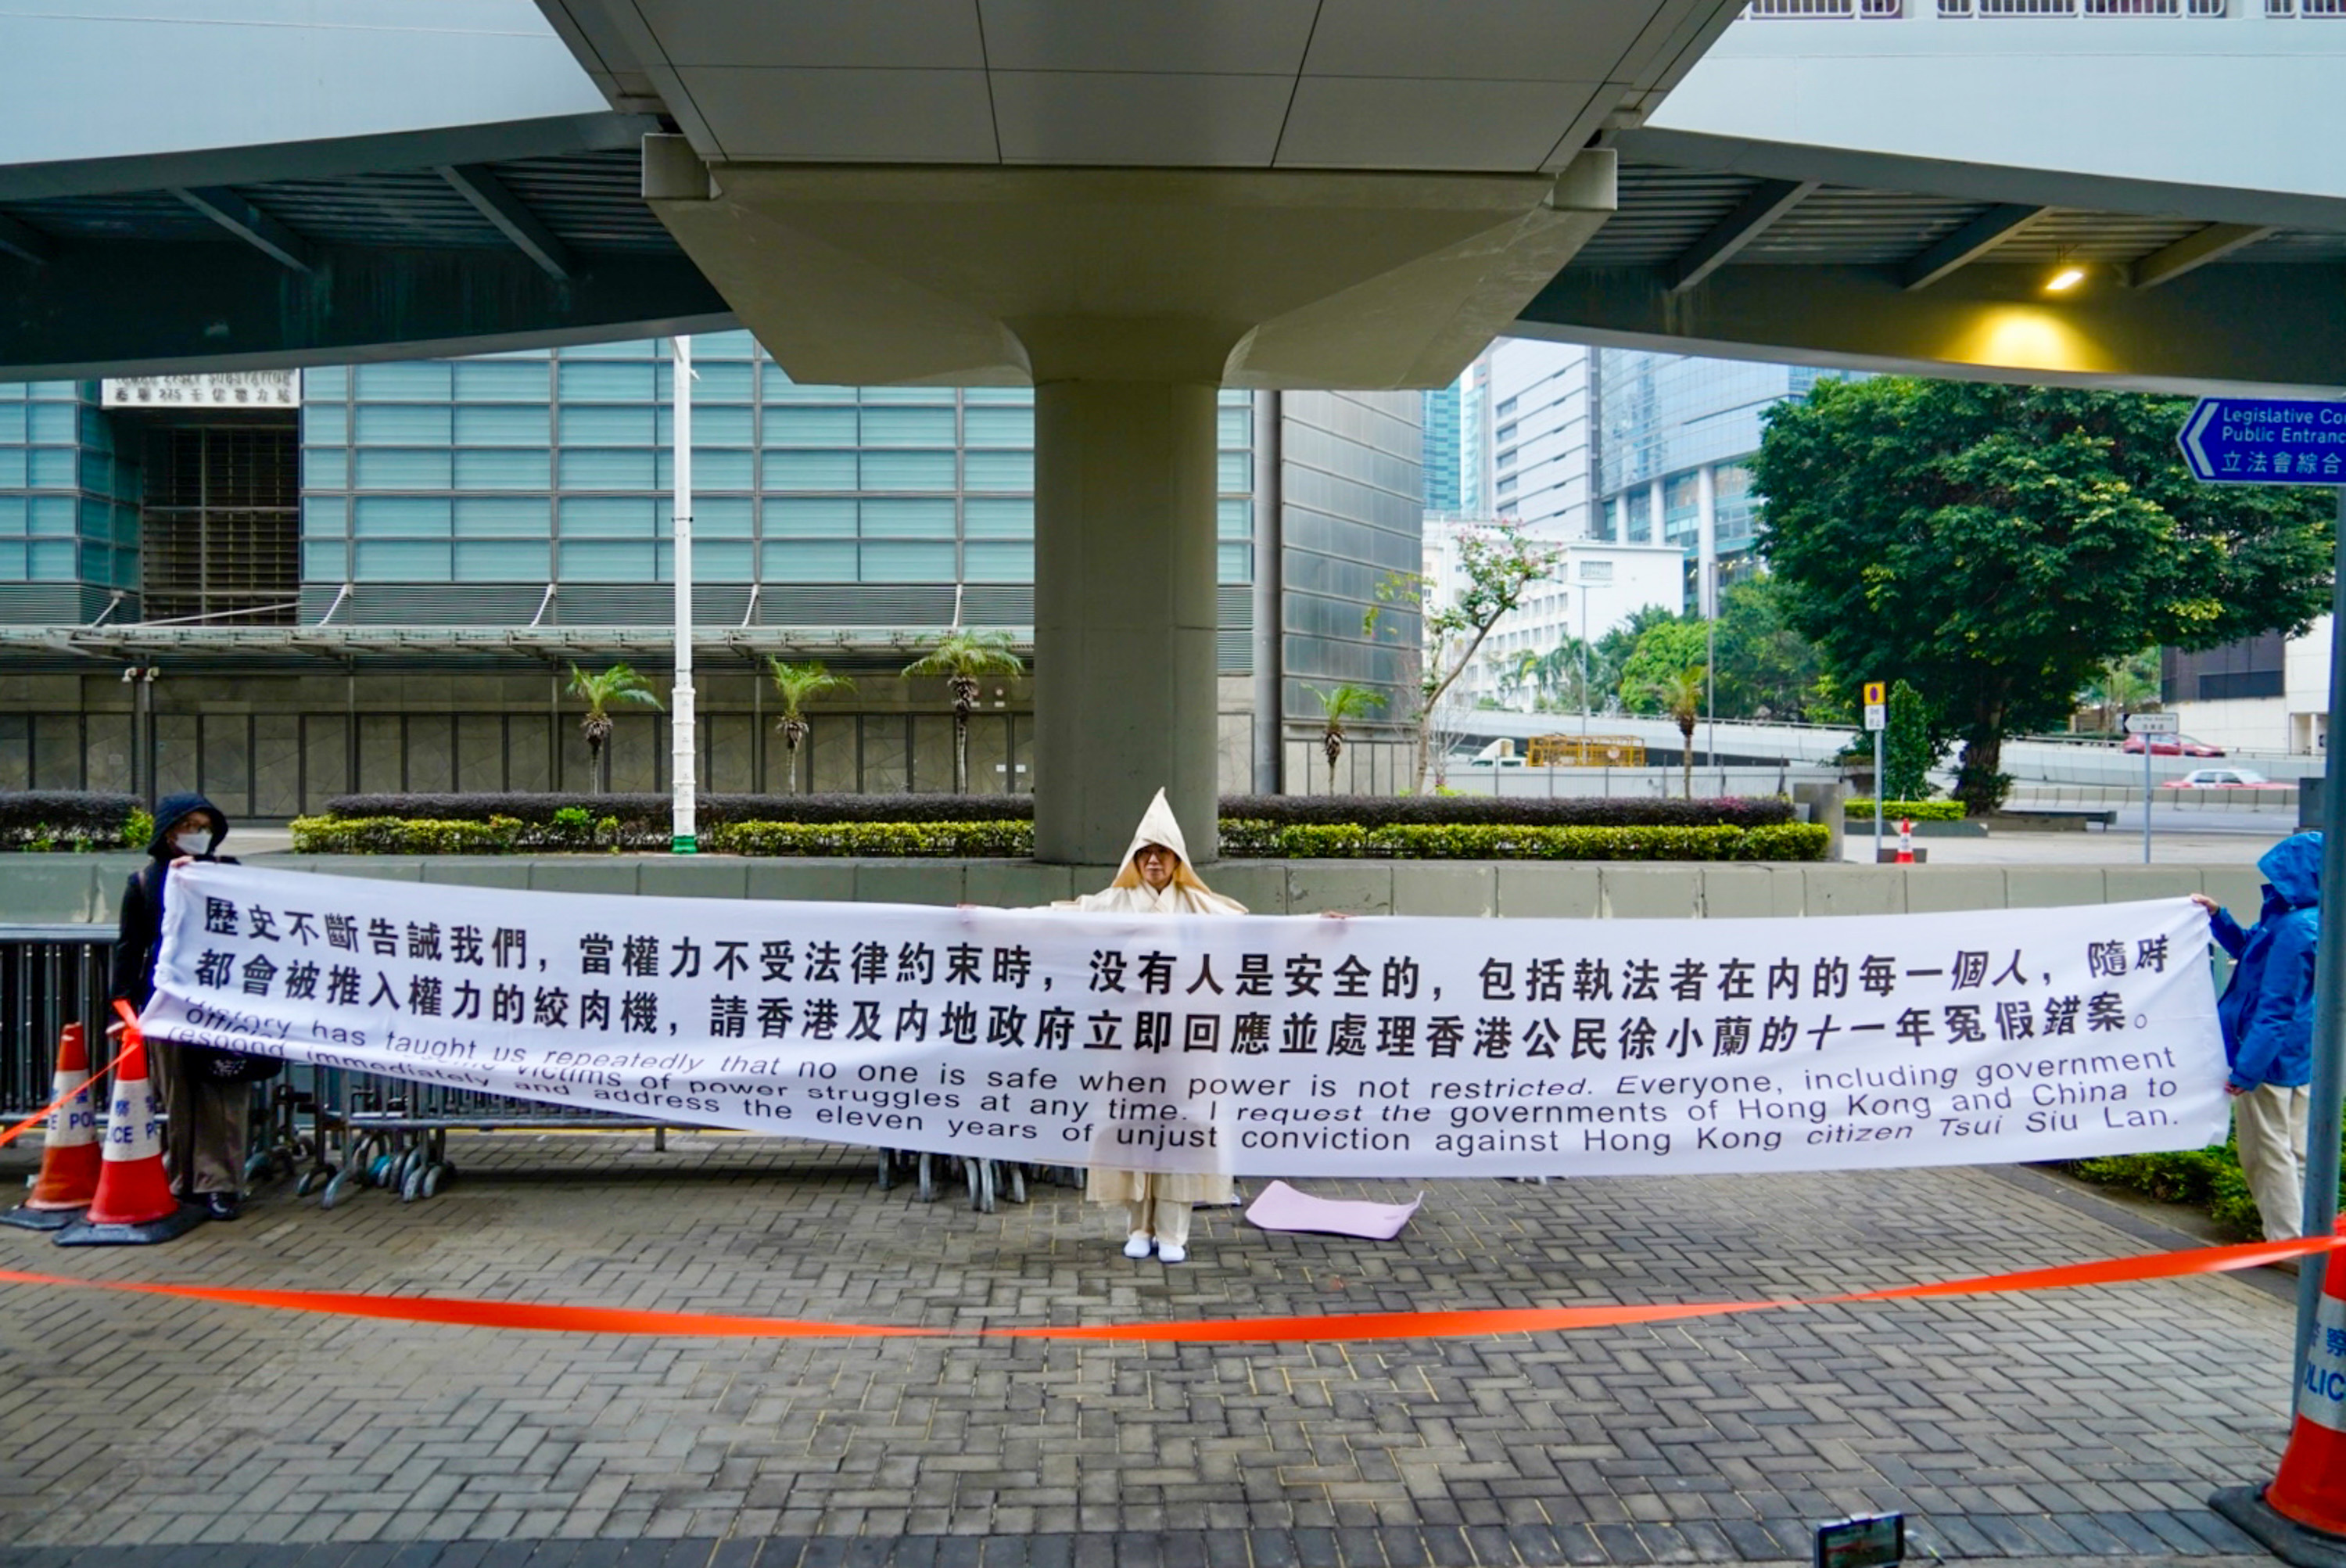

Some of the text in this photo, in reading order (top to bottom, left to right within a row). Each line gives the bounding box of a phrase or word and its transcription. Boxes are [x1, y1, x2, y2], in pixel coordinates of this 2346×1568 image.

[2222, 425, 2275, 443] Public
[2223, 406, 2346, 425] Legislative Co
[311, 1019, 367, 1046] has
[385, 1030, 477, 1060] taught
[493, 1046, 527, 1064] us
[543, 1050, 705, 1074] repeatedly
[720, 1054, 781, 1076] that
[798, 1060, 837, 1079] no
[858, 1064, 919, 1084] one
[939, 1062, 966, 1085] is
[987, 1067, 1058, 1089] safe
[1079, 1070, 1167, 1094] when
[1187, 1076, 1291, 1100] power
[1311, 1074, 1337, 1096] is
[1358, 1077, 1411, 1100] not
[1429, 1077, 1594, 1100] restricted.
[1616, 1075, 1783, 1100] Everyone,
[1804, 1064, 1958, 1092] including
[1975, 1046, 2177, 1087] government
[306, 1046, 490, 1088] immediately
[515, 1080, 571, 1096] and
[594, 1089, 720, 1113] address
[743, 1099, 793, 1120] the
[816, 1105, 924, 1132] eleven
[948, 1117, 1038, 1139] years
[1062, 1123, 1095, 1143] of
[1116, 1125, 1218, 1152] unjust
[1241, 1126, 1411, 1150] conviction
[1434, 1129, 1559, 1158] against
[1584, 1128, 1672, 1156] Hong
[1696, 1126, 1783, 1152] Kong
[1806, 1122, 1914, 1146] citizen
[1939, 1114, 2003, 1137] Tsui
[2025, 1110, 2078, 1133] Siu
[2104, 1106, 2179, 1128] Lan.
[640, 1072, 670, 1090] of
[689, 1079, 789, 1096] power
[807, 1084, 961, 1110] struggles
[980, 1093, 1010, 1112] at
[1029, 1098, 1089, 1123] any
[1107, 1098, 1187, 1121] time.
[1210, 1100, 1217, 1121] I
[1236, 1104, 1363, 1125] request
[1381, 1104, 1432, 1122] the
[1449, 1101, 1667, 1128] governments
[1687, 1100, 1719, 1121] of
[1738, 1097, 1827, 1124] Hong
[1848, 1093, 1932, 1119] Kong
[1951, 1086, 2012, 1112] and
[2032, 1081, 2128, 1107] China
[2147, 1077, 2178, 1099] to
